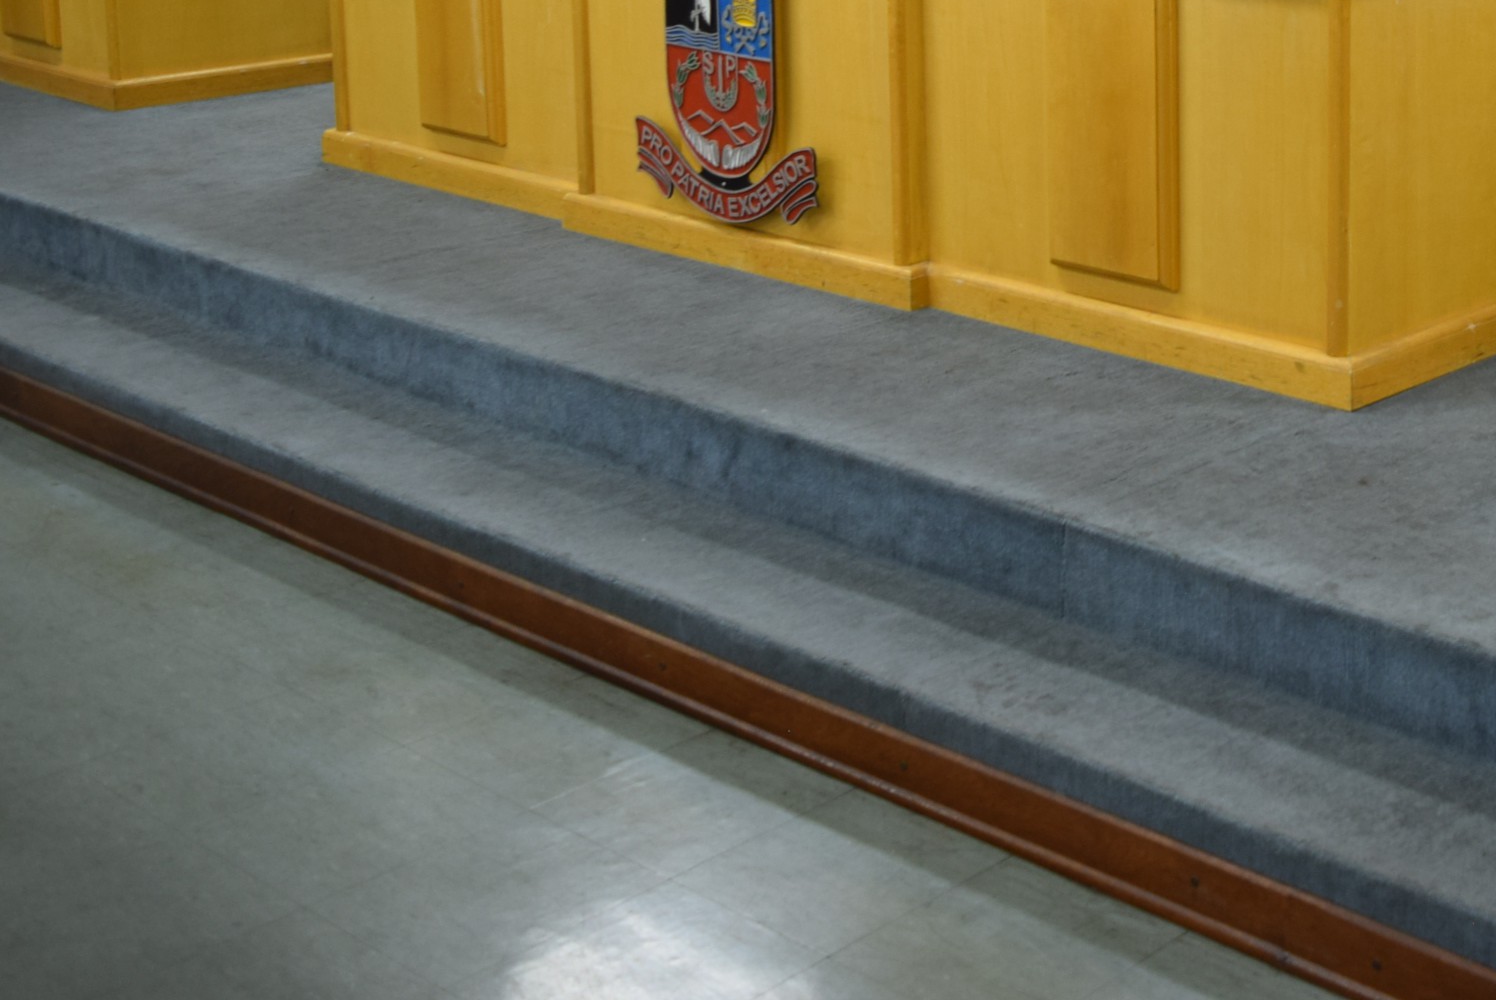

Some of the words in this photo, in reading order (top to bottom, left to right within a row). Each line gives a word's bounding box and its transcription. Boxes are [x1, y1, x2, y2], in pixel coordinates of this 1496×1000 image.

[641, 126, 673, 165] PRO
[671, 165, 725, 215] PATRIA
[728, 155, 811, 217] EXCELSIOR
